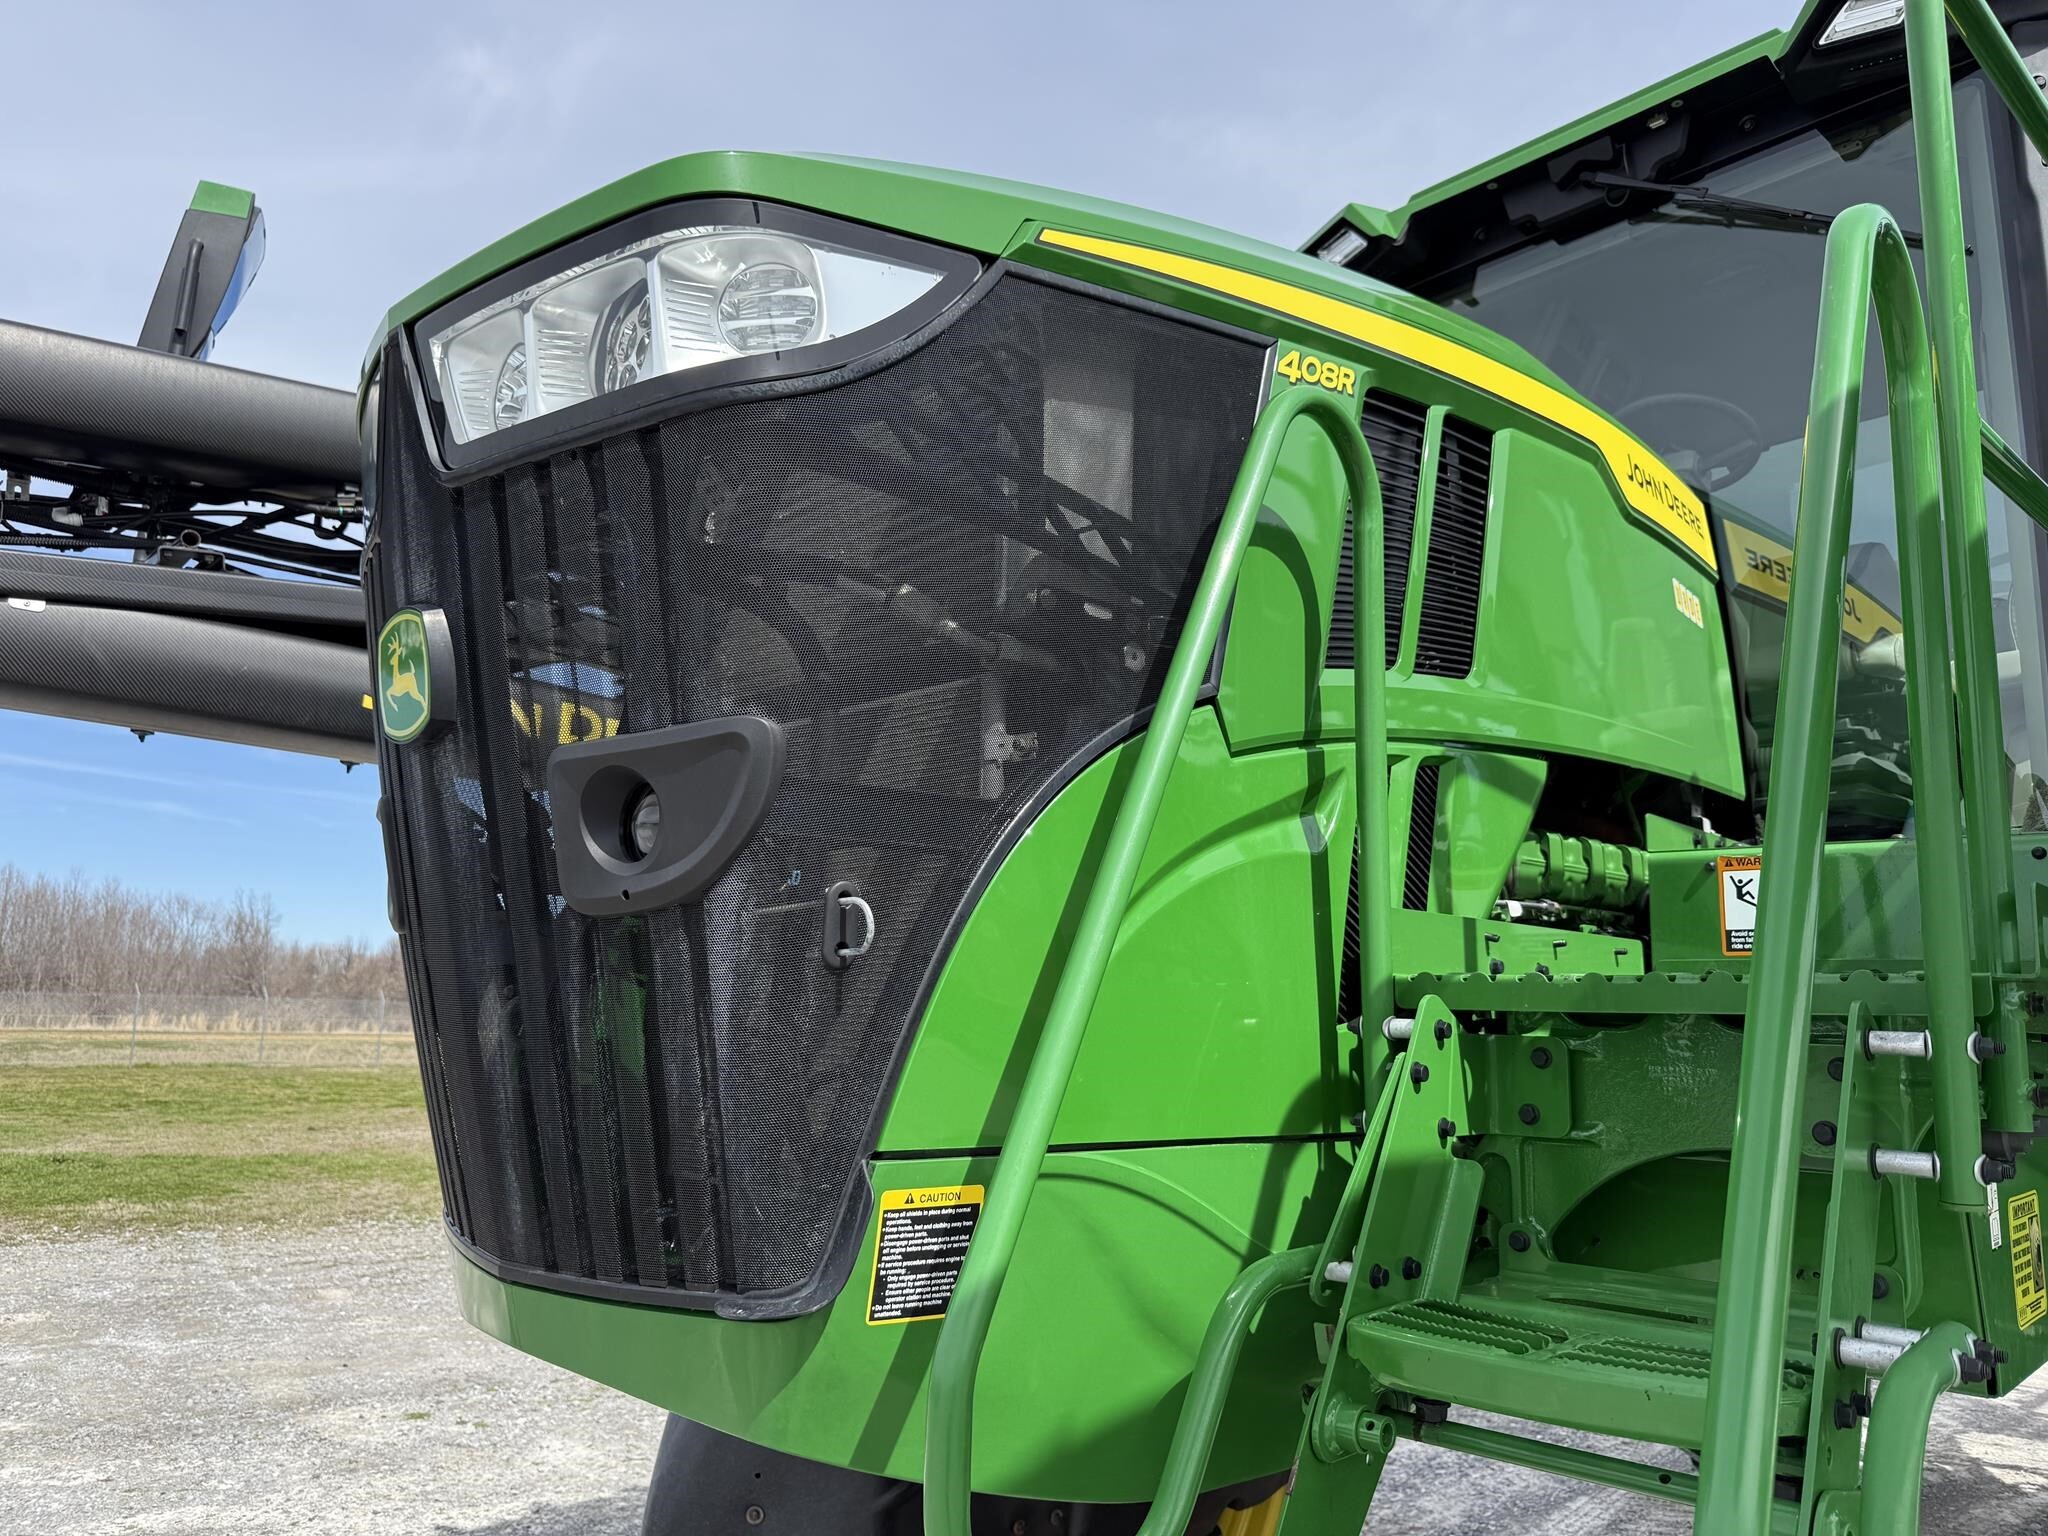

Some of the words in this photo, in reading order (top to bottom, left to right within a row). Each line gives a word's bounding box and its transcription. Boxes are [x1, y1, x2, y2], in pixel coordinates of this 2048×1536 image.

[1277, 350, 1355, 395] 408R
[1627, 454, 1664, 504] JOHN
[1663, 481, 1704, 540] DEERE
[1736, 857, 1761, 866] WAR
[920, 1192, 961, 1203] CAUTION
